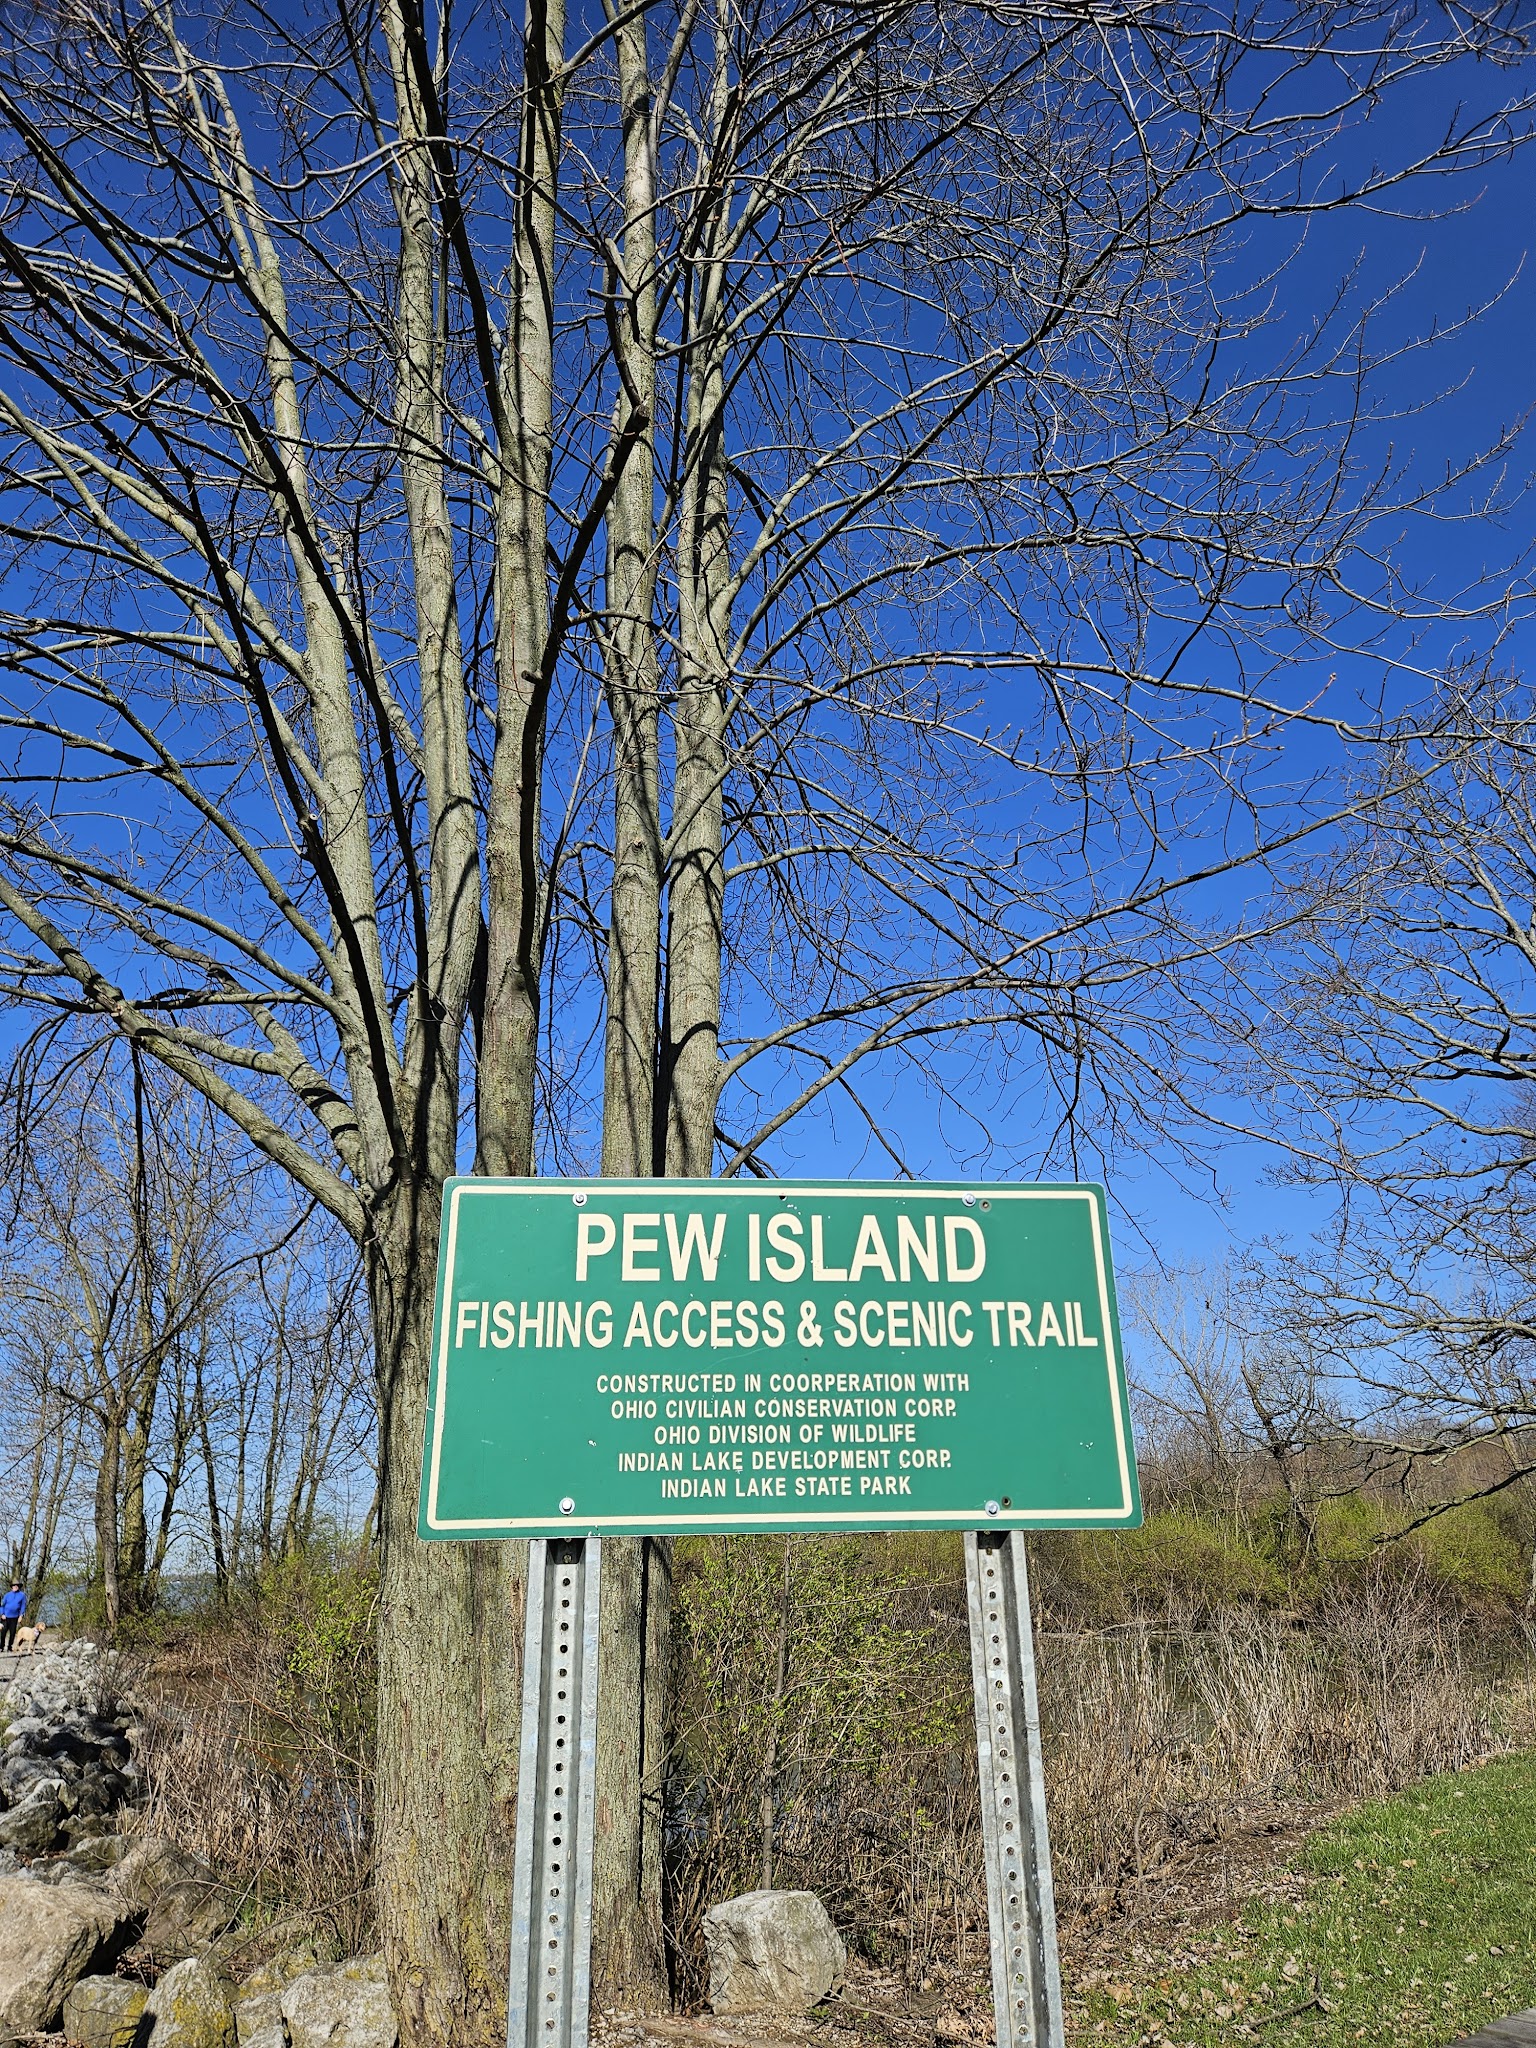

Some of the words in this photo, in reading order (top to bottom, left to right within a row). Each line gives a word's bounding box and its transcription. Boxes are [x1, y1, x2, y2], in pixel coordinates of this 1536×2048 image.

[576, 1213, 727, 1283] PEW
[749, 1213, 987, 1283] ISLAND
[455, 1301, 613, 1349] FISHING
[624, 1300, 786, 1349] ACCESS
[796, 1300, 824, 1348] &
[834, 1300, 974, 1348] SCENIC
[981, 1301, 1099, 1347] TRAIL
[597, 1374, 736, 1394] CONSTRUCTED
[744, 1373, 761, 1393] IN
[769, 1373, 916, 1393] COORPERATION
[923, 1373, 970, 1393] WITH
[611, 1400, 657, 1420] OHIO
[665, 1399, 746, 1419] CIVILIAN
[754, 1398, 897, 1418] CONSERVATION
[904, 1398, 957, 1417] CORP.
[654, 1425, 701, 1445] OHIO
[709, 1424, 791, 1444] DIVISION
[799, 1424, 824, 1444] OF
[831, 1423, 916, 1443] WILDLIFE
[618, 1452, 683, 1472] INDIAN
[692, 1451, 743, 1471] LAKE
[752, 1449, 891, 1470] DEVELOPMENT
[898, 1449, 952, 1469] CORP.
[661, 1478, 726, 1498] INDIAN
[735, 1477, 787, 1497] LAKE
[794, 1476, 852, 1497] STATE
[860, 1475, 912, 1495] PARK
